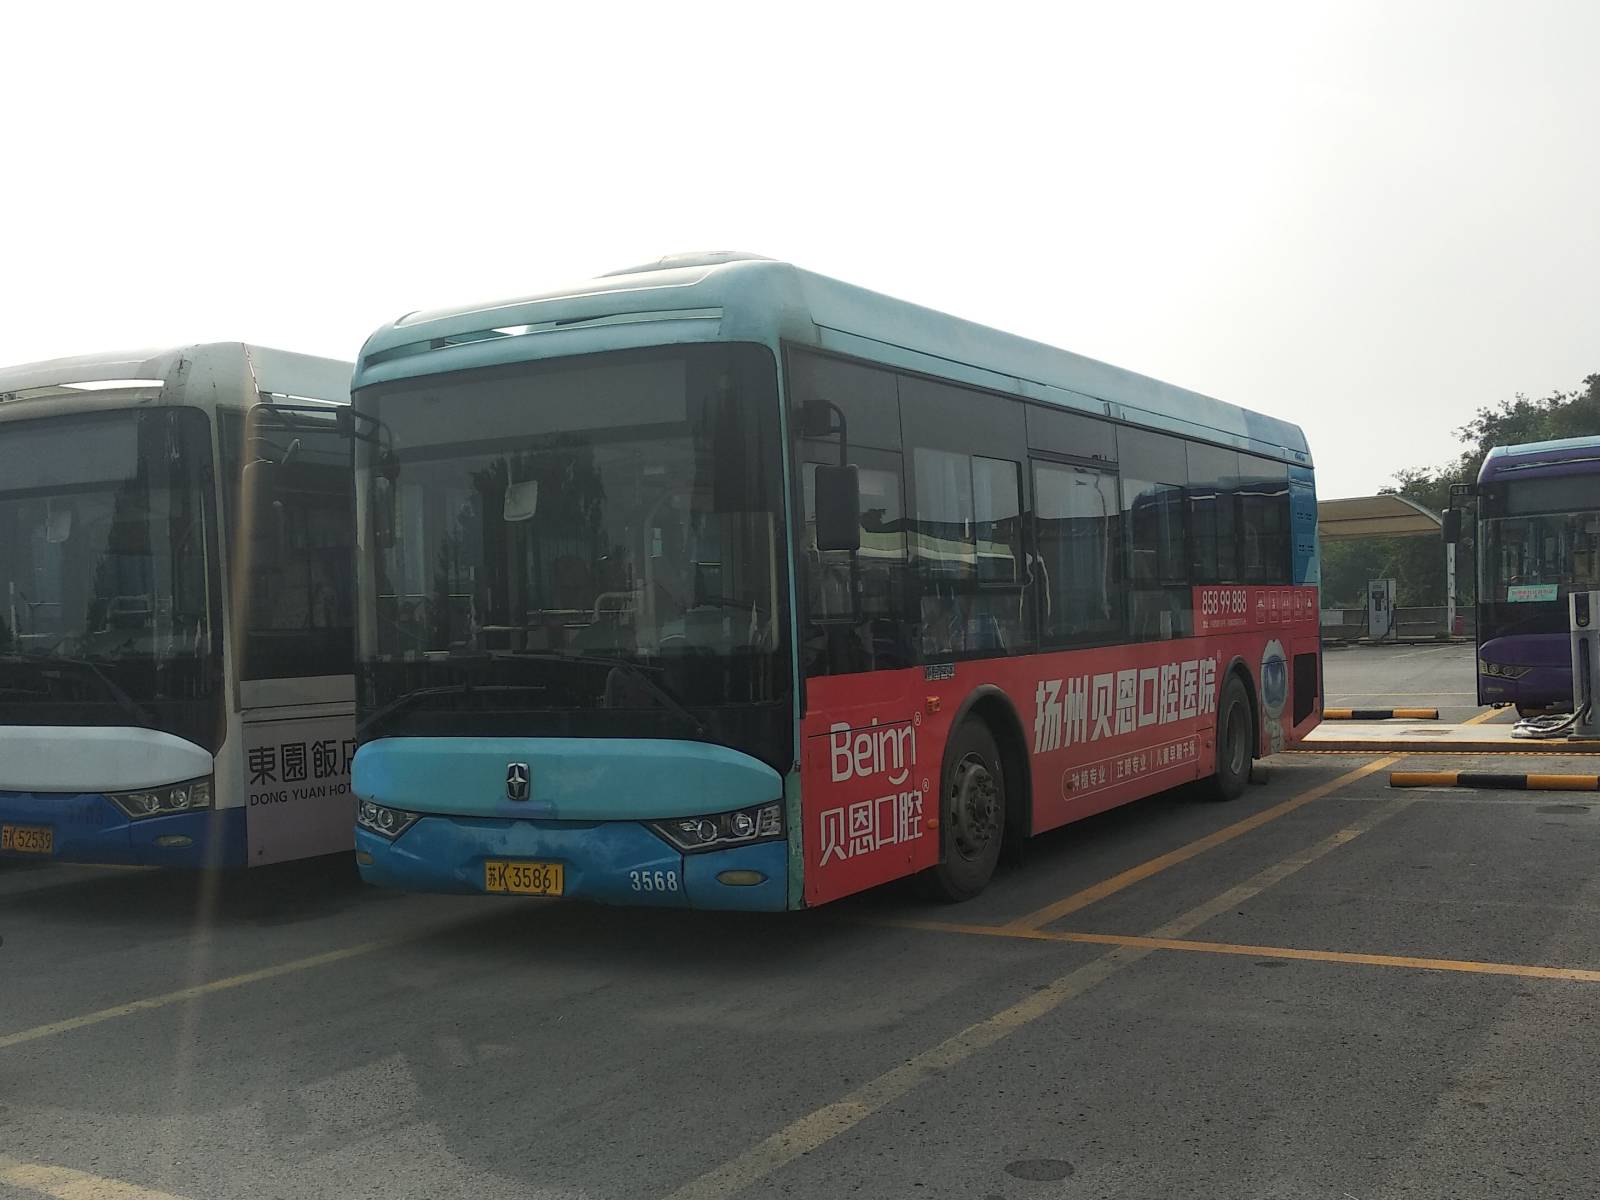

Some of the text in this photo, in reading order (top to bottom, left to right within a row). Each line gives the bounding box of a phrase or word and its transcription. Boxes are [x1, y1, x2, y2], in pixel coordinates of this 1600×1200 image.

[1202, 590, 1247, 615] 858 99 888
[1033, 656, 1217, 755] 扬州贝恩口腔医院
[250, 790, 288, 807] DONG
[291, 785, 326, 801] YUAN
[819, 789, 923, 867] 贝恩口腔
[629, 870, 678, 892] 3568
